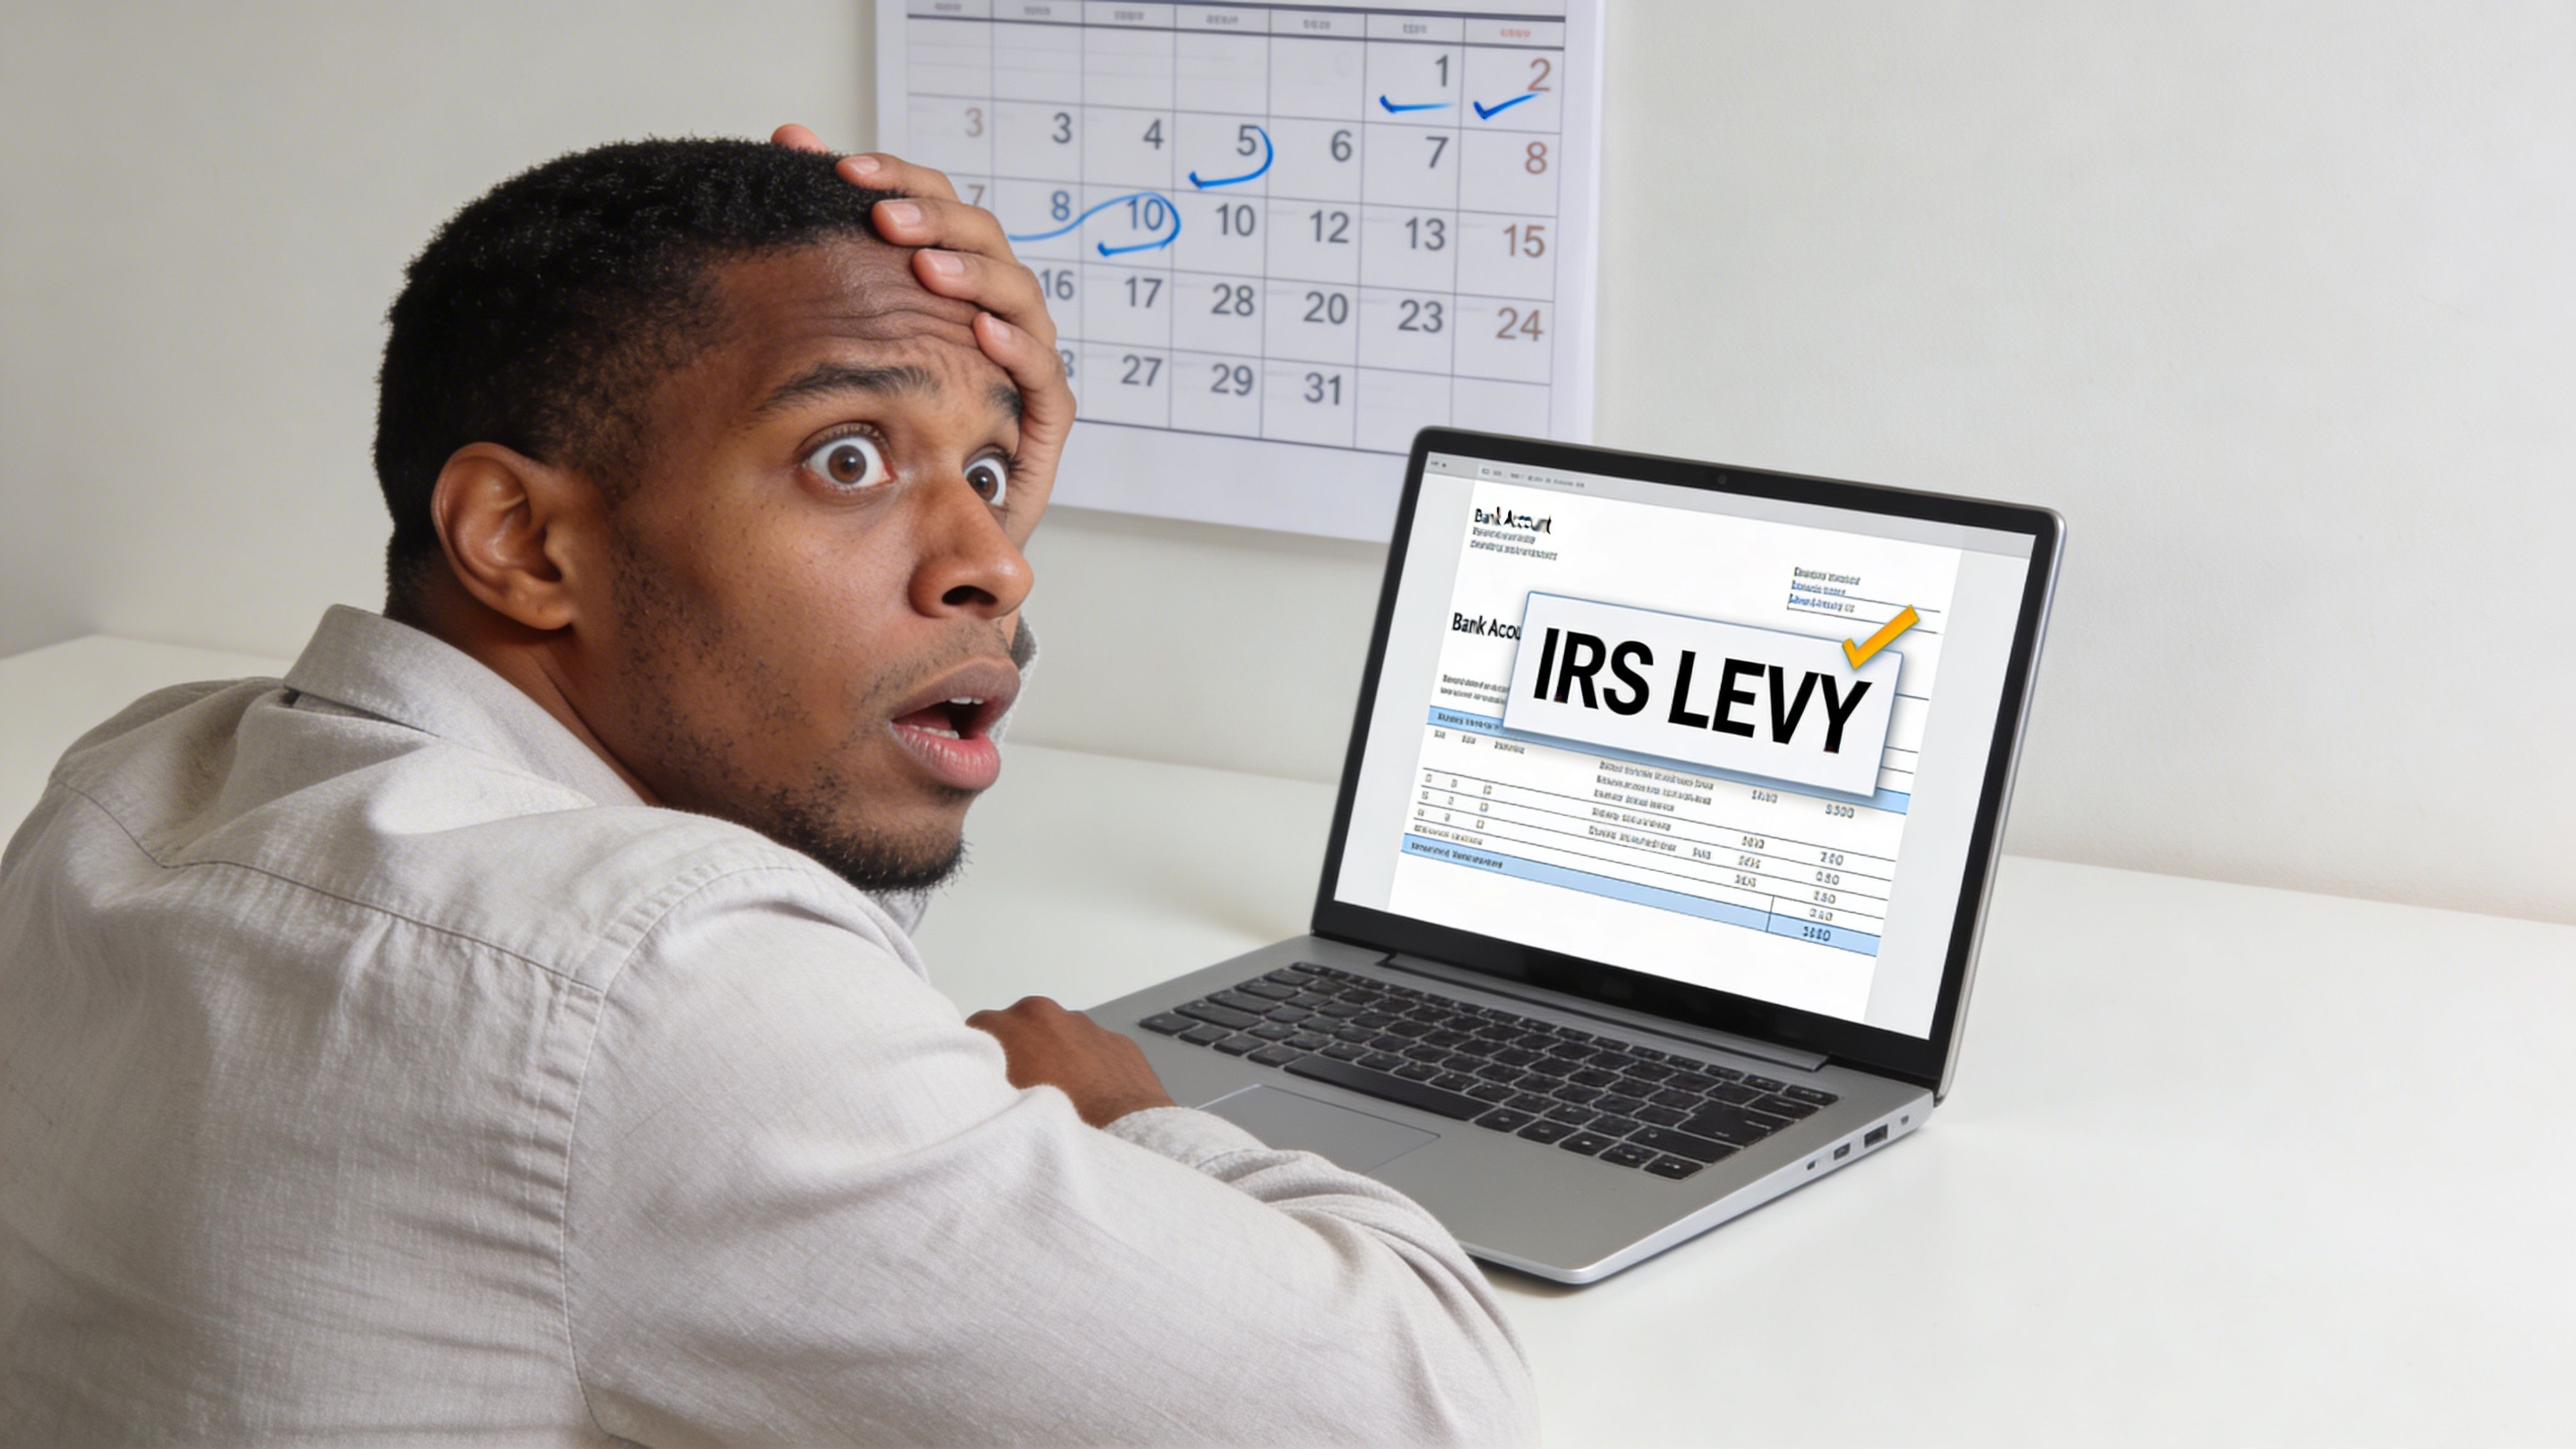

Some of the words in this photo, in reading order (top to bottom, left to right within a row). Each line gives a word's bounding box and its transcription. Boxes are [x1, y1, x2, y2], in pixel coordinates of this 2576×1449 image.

[1435, 54, 1448, 87] 1
[1528, 57, 1551, 91] 2
[965, 108, 983, 137] 3
[1052, 111, 1071, 144] 3
[1143, 118, 1164, 150] 4
[1236, 125, 1257, 156] 5
[1331, 130, 1352, 162] 6
[1426, 136, 1448, 168] 7
[1525, 142, 1547, 174] 8
[1052, 191, 1070, 221] 8
[1127, 199, 1163, 230] 10
[1216, 204, 1255, 236] 10
[1310, 209, 1350, 243] 12
[1405, 217, 1445, 250] 13
[1503, 225, 1545, 257] 15
[1041, 269, 1074, 300] 16
[1124, 277, 1162, 308] 17
[1211, 284, 1255, 316] 28
[1304, 291, 1348, 325] 20
[1397, 299, 1443, 333] 23
[1496, 308, 1543, 341] 24
[1121, 355, 1162, 386] 27
[1210, 364, 1253, 396] 29
[1304, 372, 1341, 405] 31
[1475, 506, 1502, 526] Bank
[1452, 612, 1487, 636] Bank
[1533, 628, 1653, 716] IRS
[1668, 650, 1873, 753] LEVY
